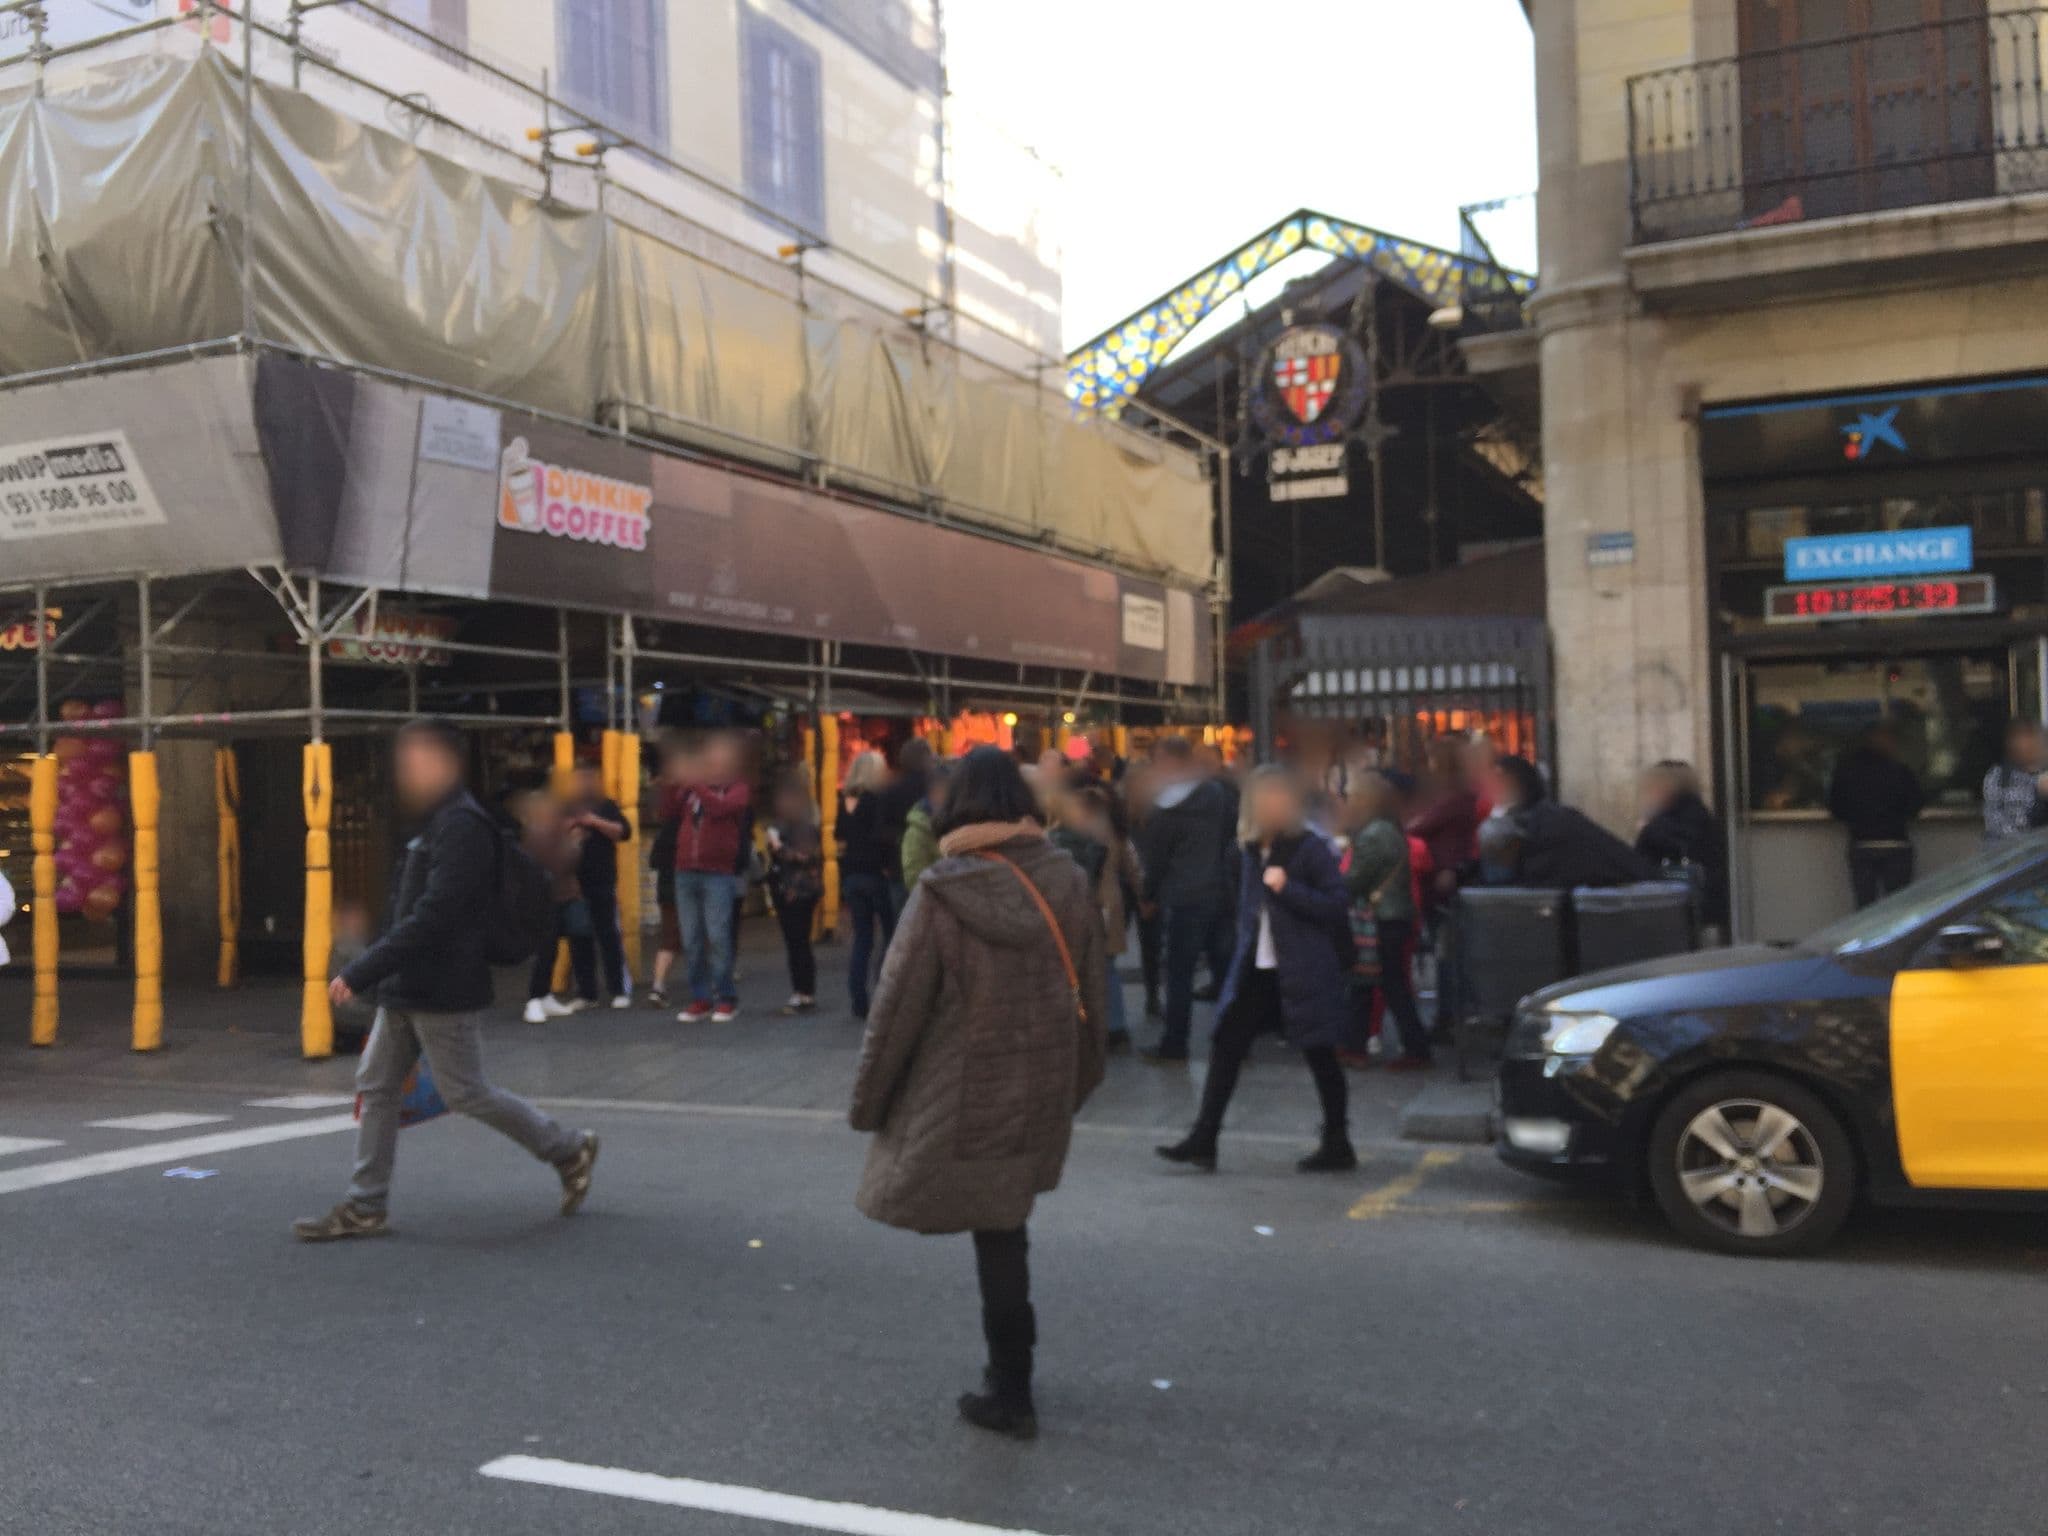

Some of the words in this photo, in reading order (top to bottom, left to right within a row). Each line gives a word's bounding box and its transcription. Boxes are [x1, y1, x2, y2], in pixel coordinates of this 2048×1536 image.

[106, 479, 138, 504] 00
[546, 501, 644, 547] COFFEE
[1796, 537, 1958, 569] EXCHANGE
